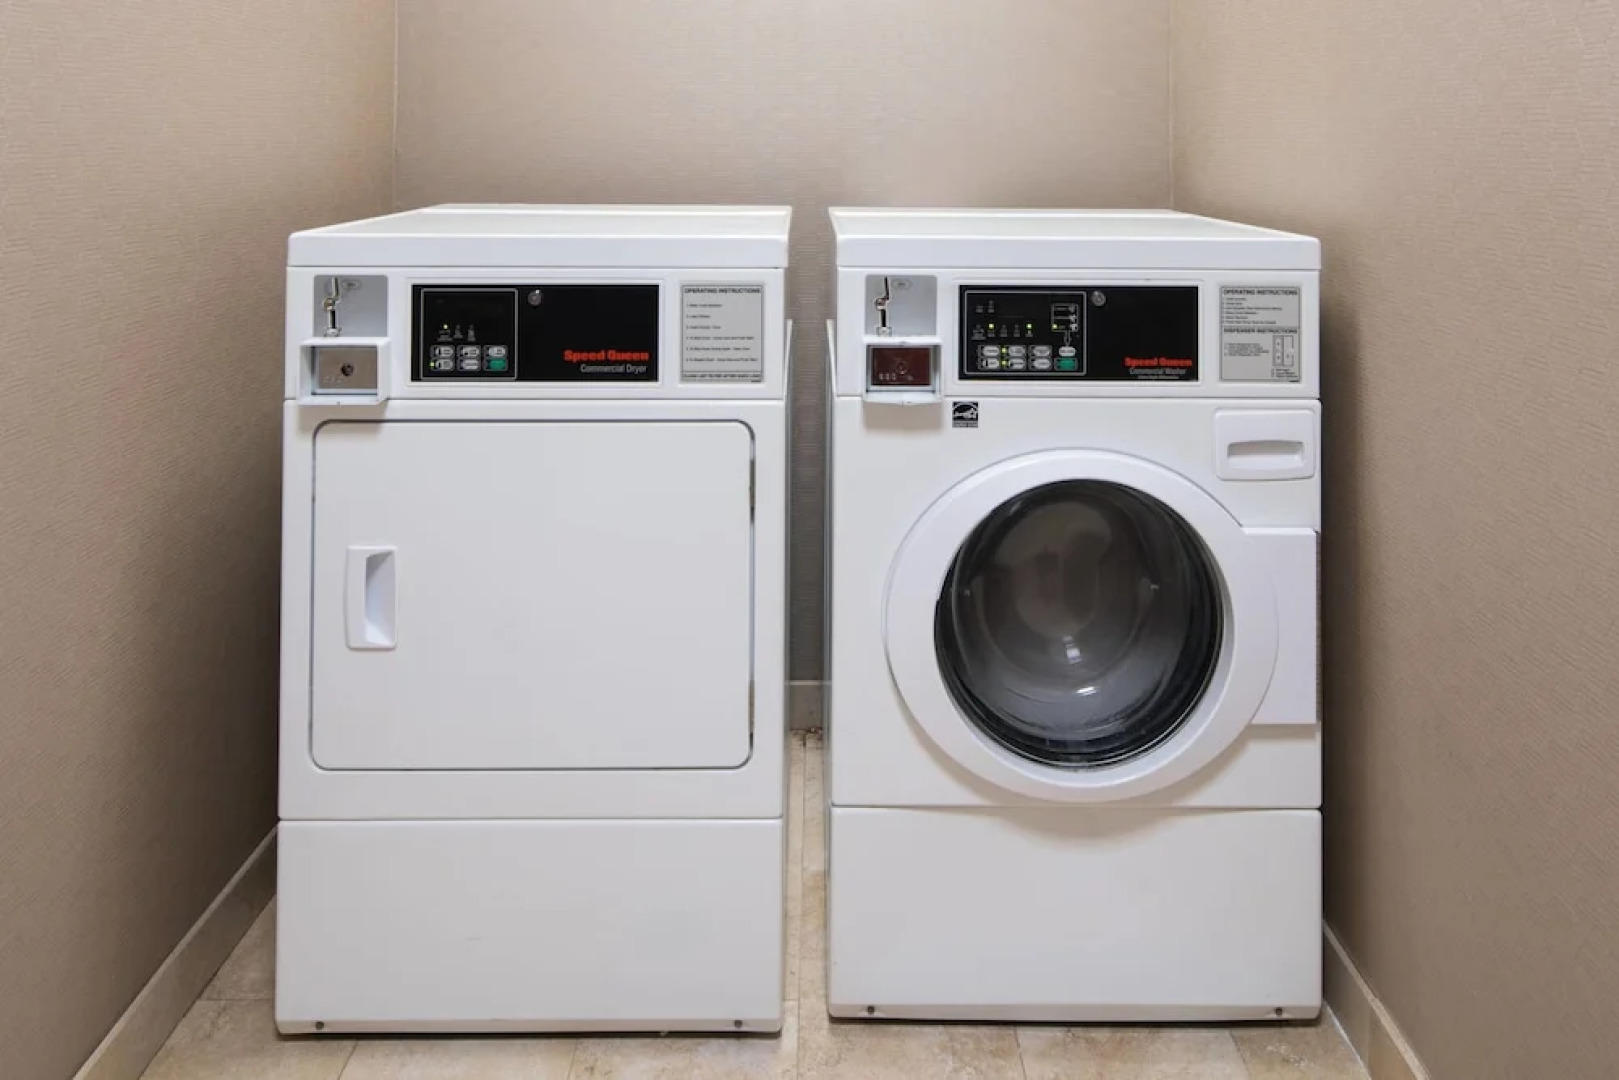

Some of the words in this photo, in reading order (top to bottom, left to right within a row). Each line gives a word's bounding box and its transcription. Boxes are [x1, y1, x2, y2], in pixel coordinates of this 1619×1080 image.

[563, 349, 605, 362] Speed
[607, 349, 649, 361] Queen
[1125, 357, 1158, 368] Speed
[1159, 357, 1192, 367] Queen
[580, 363, 625, 373] Commercial
[626, 363, 647, 374] Dryer
